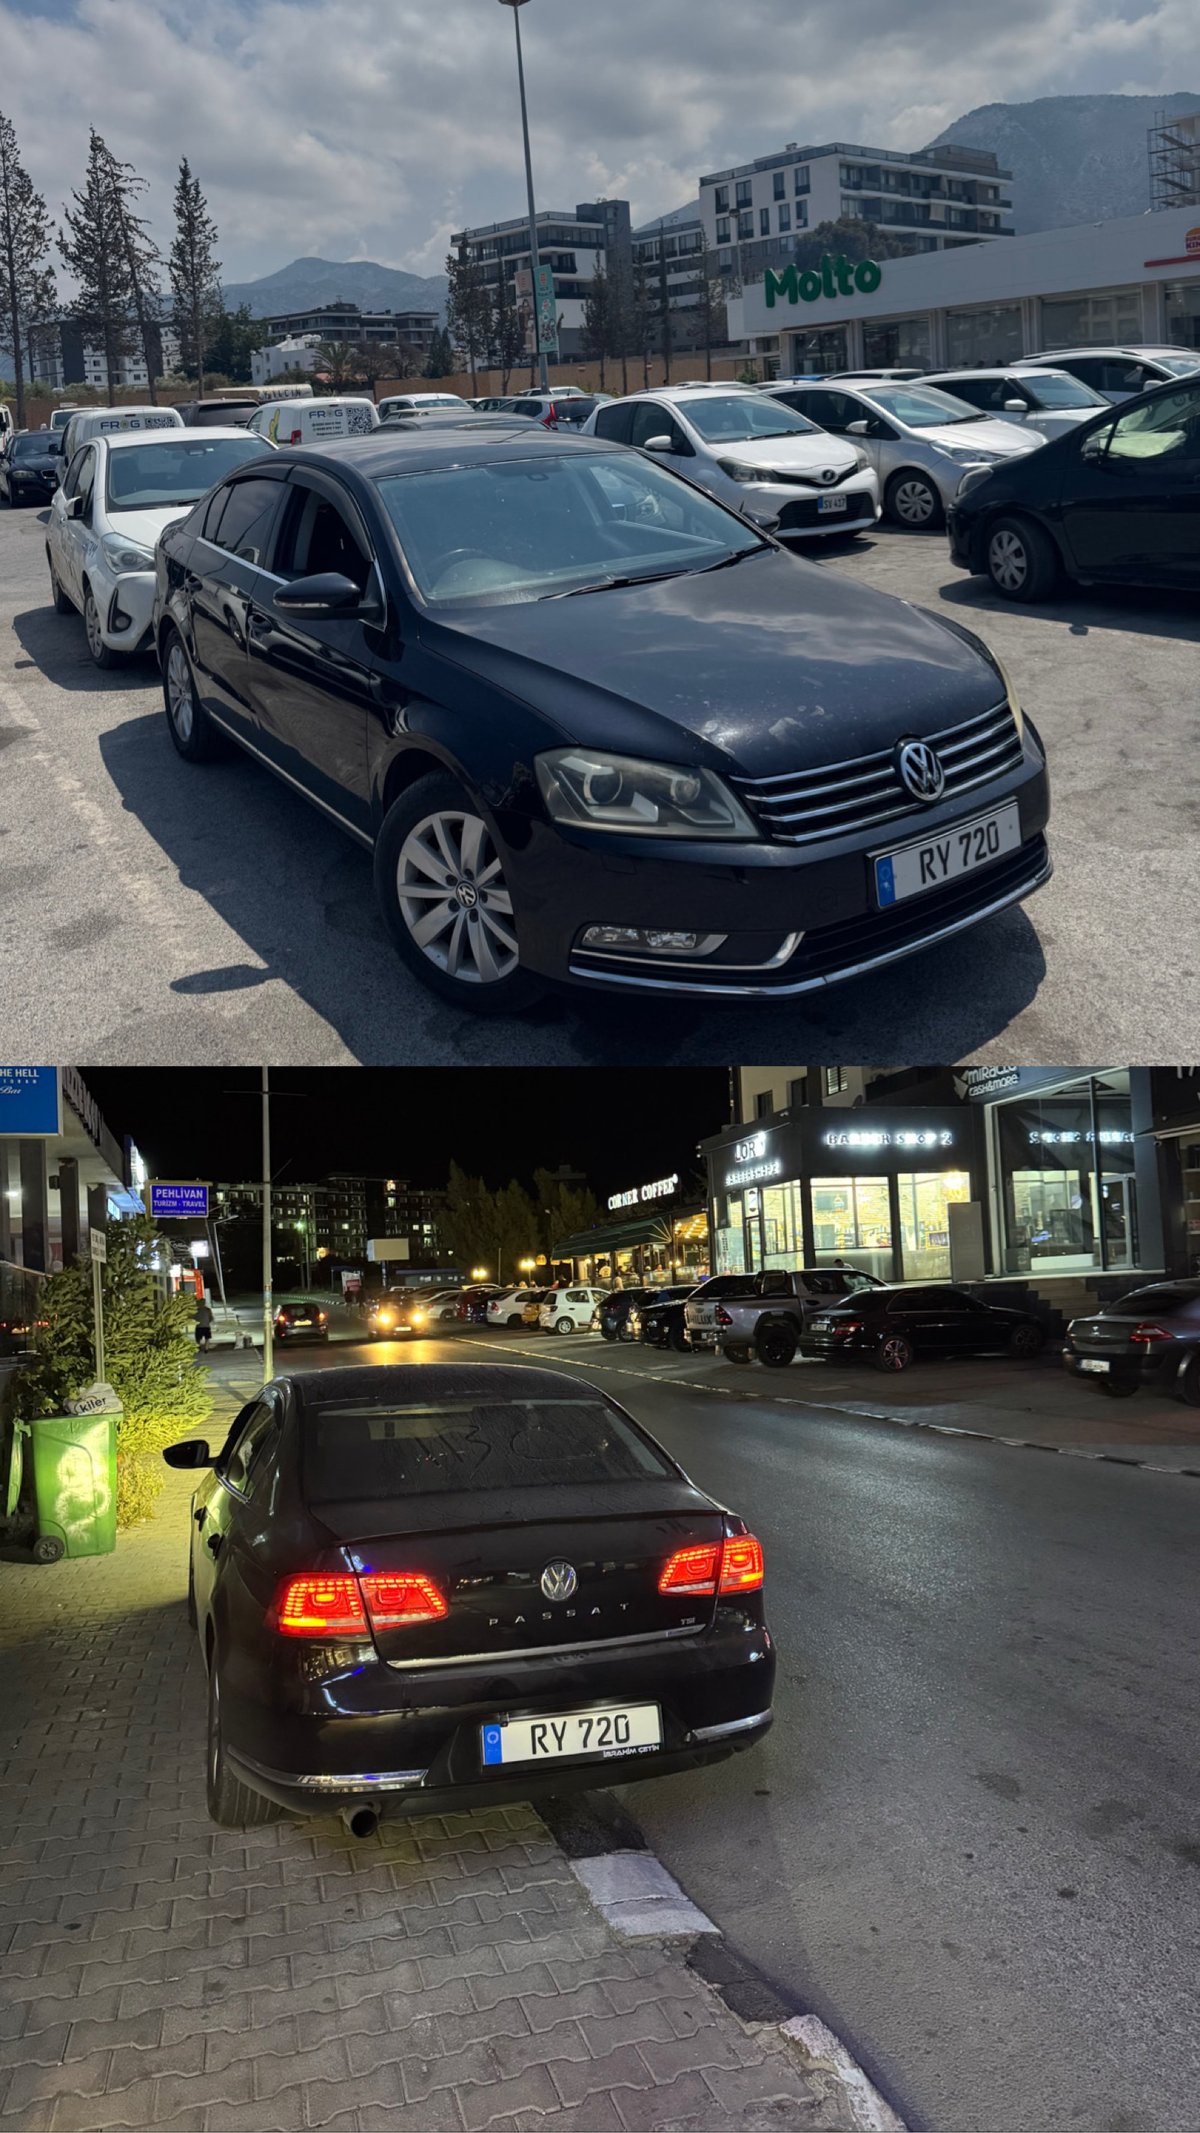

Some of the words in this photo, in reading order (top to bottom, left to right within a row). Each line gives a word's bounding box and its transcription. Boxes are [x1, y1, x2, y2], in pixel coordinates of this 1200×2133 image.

[765, 253, 882, 308] Molto
[919, 841, 950, 885] RY
[959, 820, 1000, 867] 720
[15, 1068, 40, 1078] HELL
[734, 1133, 766, 1163] LOR
[827, 1132, 892, 1146] BAR
[896, 1132, 936, 1146] SO
[941, 1131, 953, 1146] 2
[155, 1187, 204, 1199] PEHLİVAN
[607, 1188, 639, 1211] CORNER
[641, 1177, 676, 1201] COFFEE
[182, 1200, 206, 1208] TRAVEL
[79, 1396, 107, 1413] kiler
[489, 1602, 630, 1627] PASSAT
[530, 1721, 567, 1755] RY
[578, 1714, 631, 1749] 720
[603, 1747, 637, 1758] İBRAHİM
[638, 1743, 660, 1755] ÇETİN
